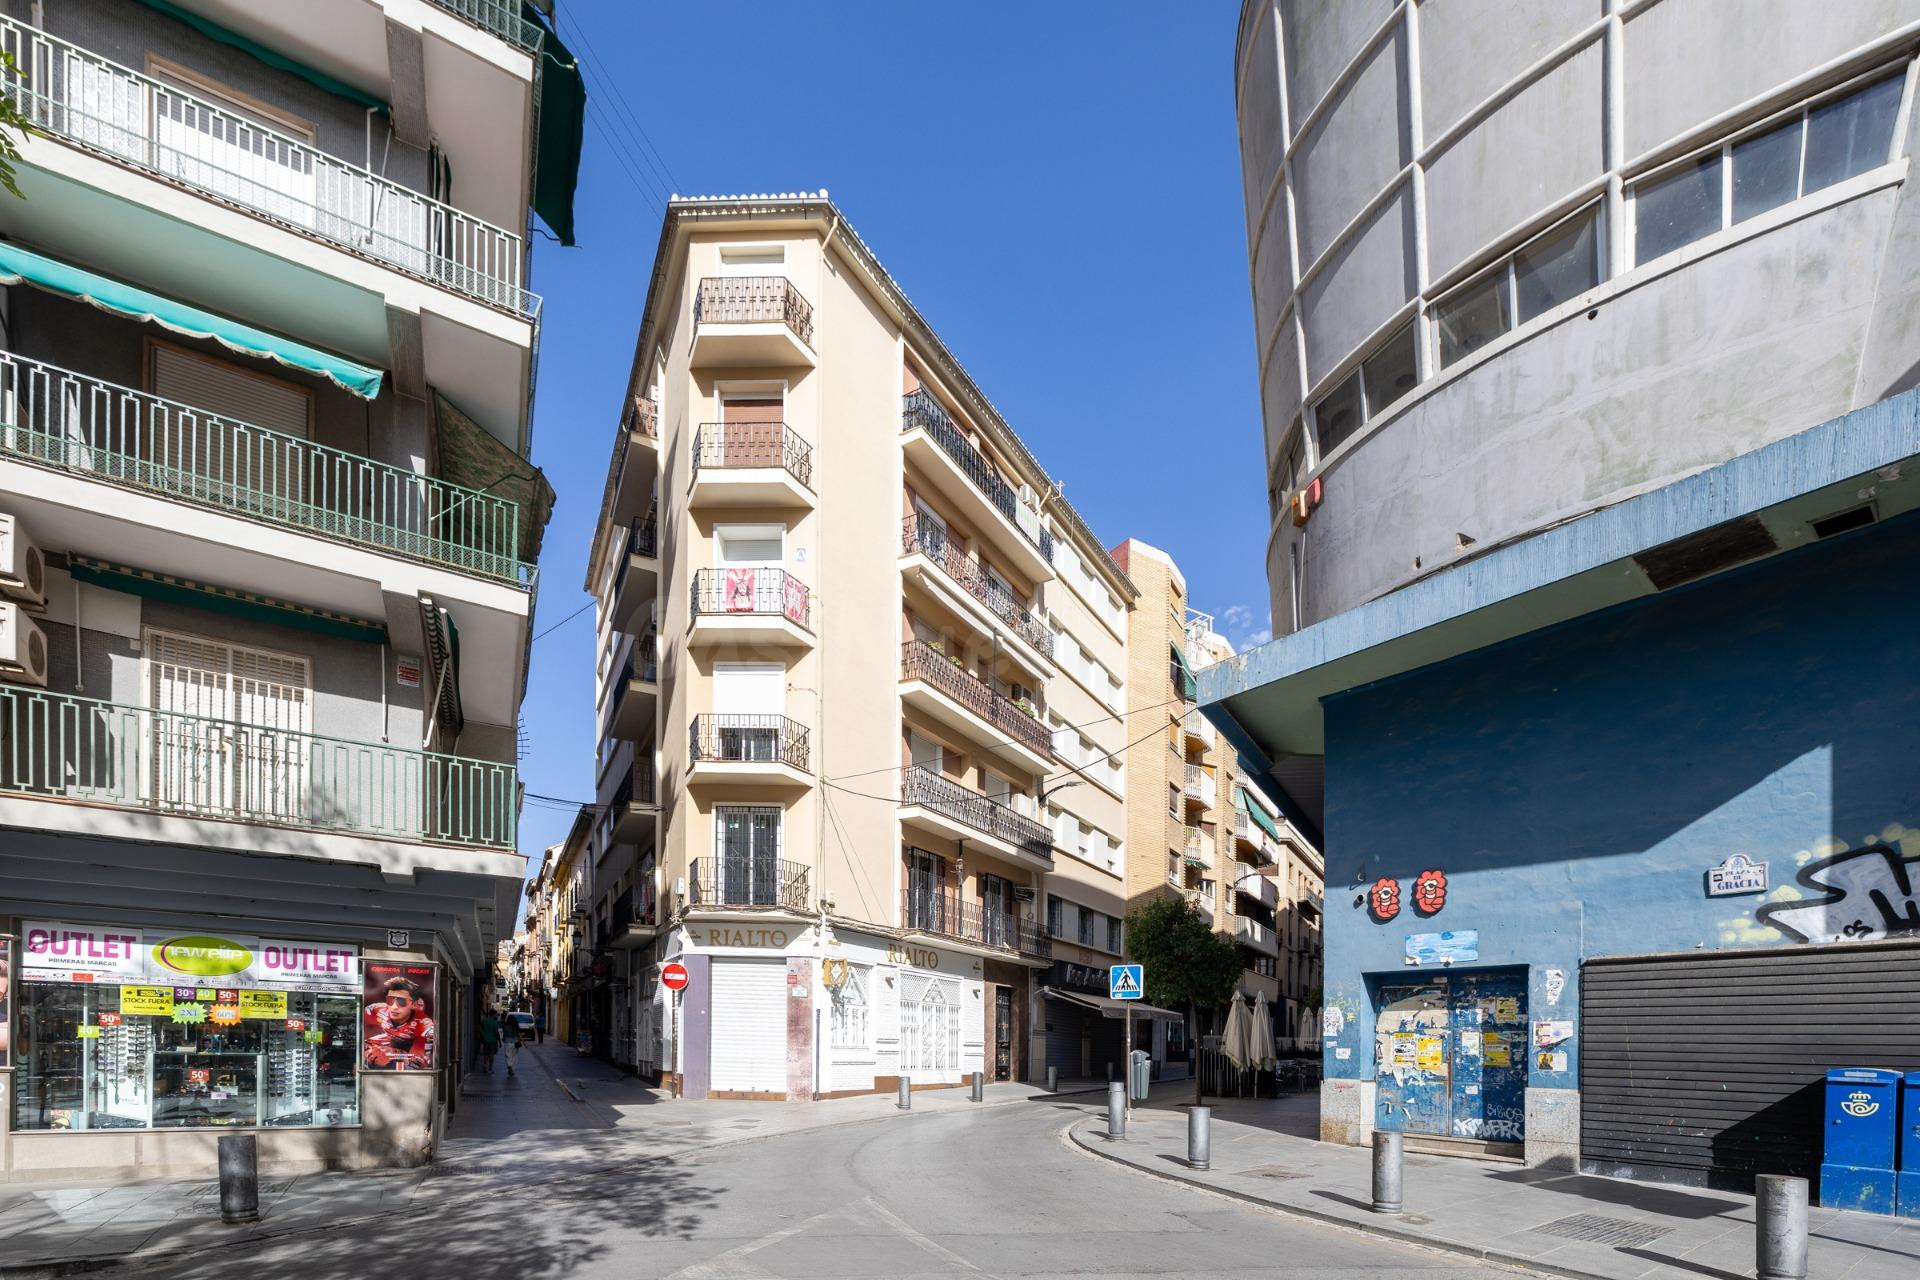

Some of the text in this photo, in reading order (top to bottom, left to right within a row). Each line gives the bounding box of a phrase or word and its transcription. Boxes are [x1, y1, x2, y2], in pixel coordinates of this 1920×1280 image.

[1717, 879, 1760, 891] GRACIA
[28, 928, 137, 960] OUTLET
[708, 928, 788, 947] RIALTO
[48, 957, 118, 967] PRIMERAS MARCAS
[264, 945, 354, 973] OUTLET
[887, 943, 939, 969] RIALTO
